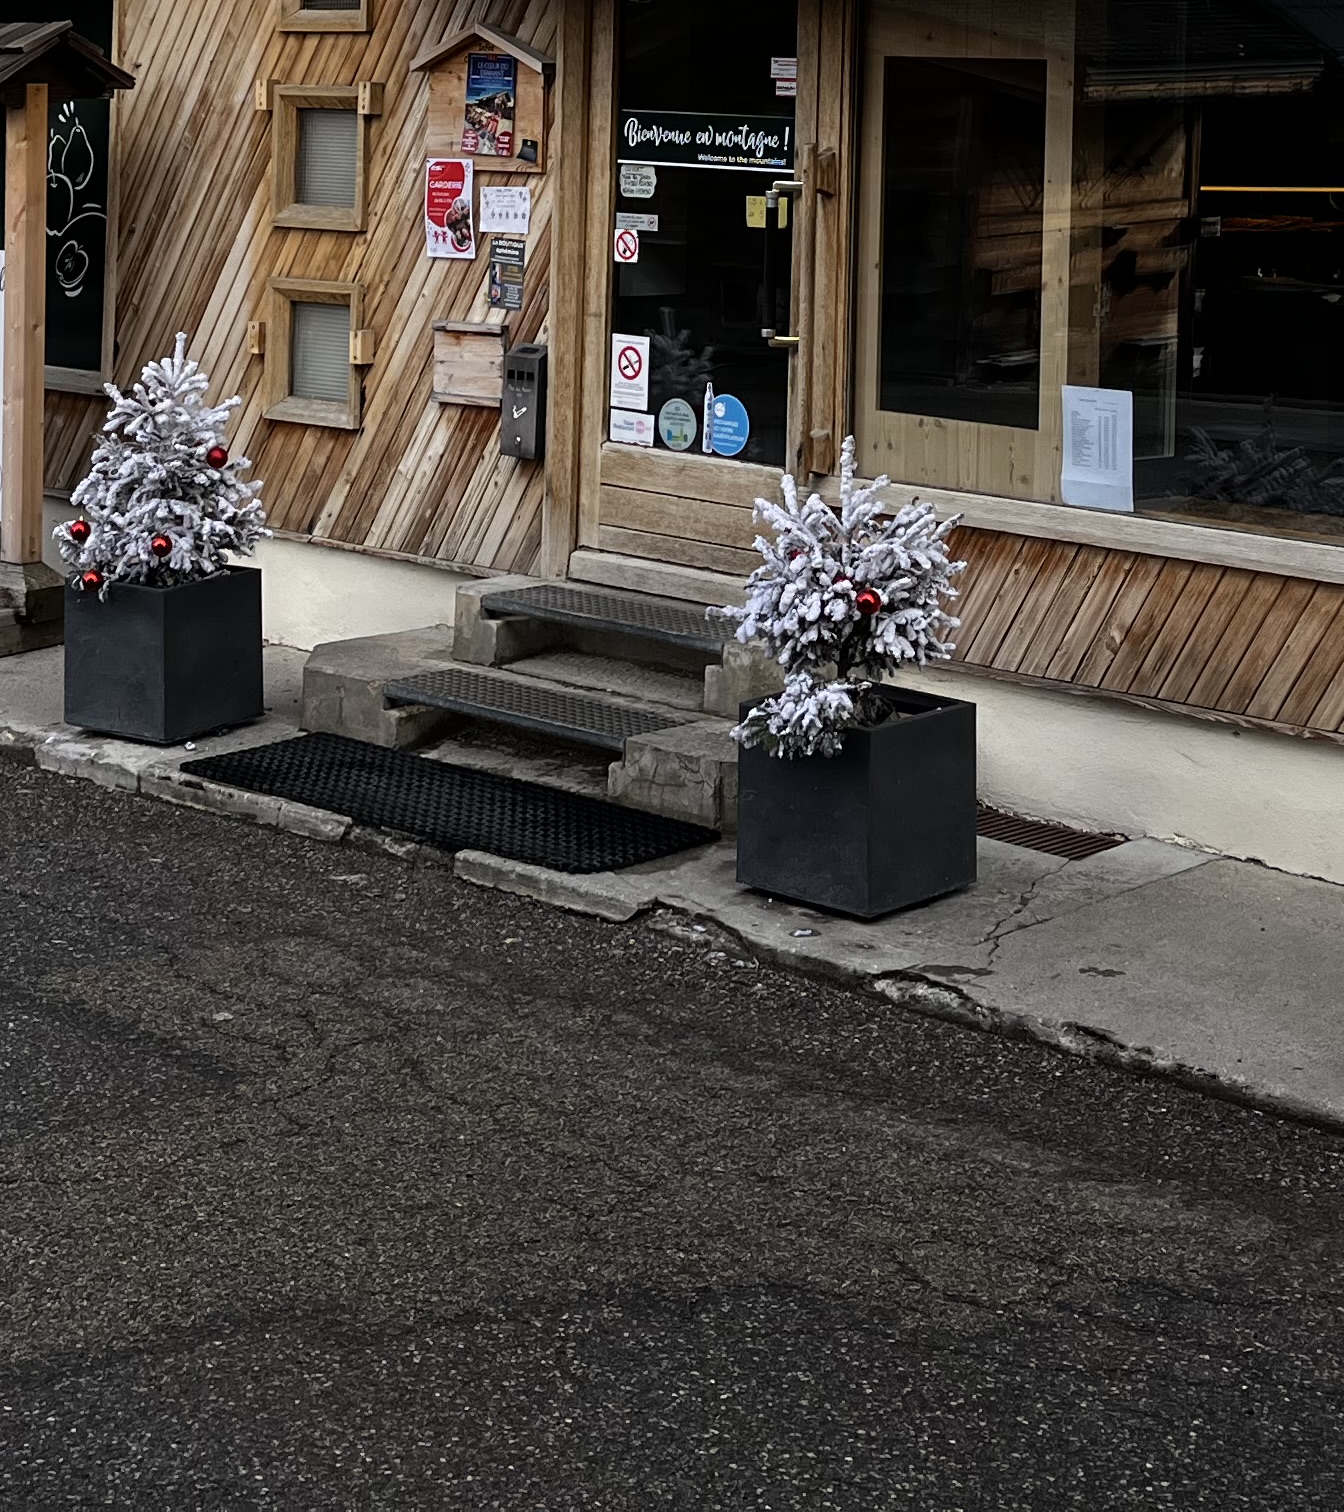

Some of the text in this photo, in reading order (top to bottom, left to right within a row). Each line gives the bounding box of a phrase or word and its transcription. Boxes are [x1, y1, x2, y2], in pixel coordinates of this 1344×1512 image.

[624, 117, 692, 147] Bienvenue
[696, 124, 714, 146] en
[715, 124, 780, 158] montagne
[698, 153, 728, 162] Welcome
[736, 156, 748, 164] the
